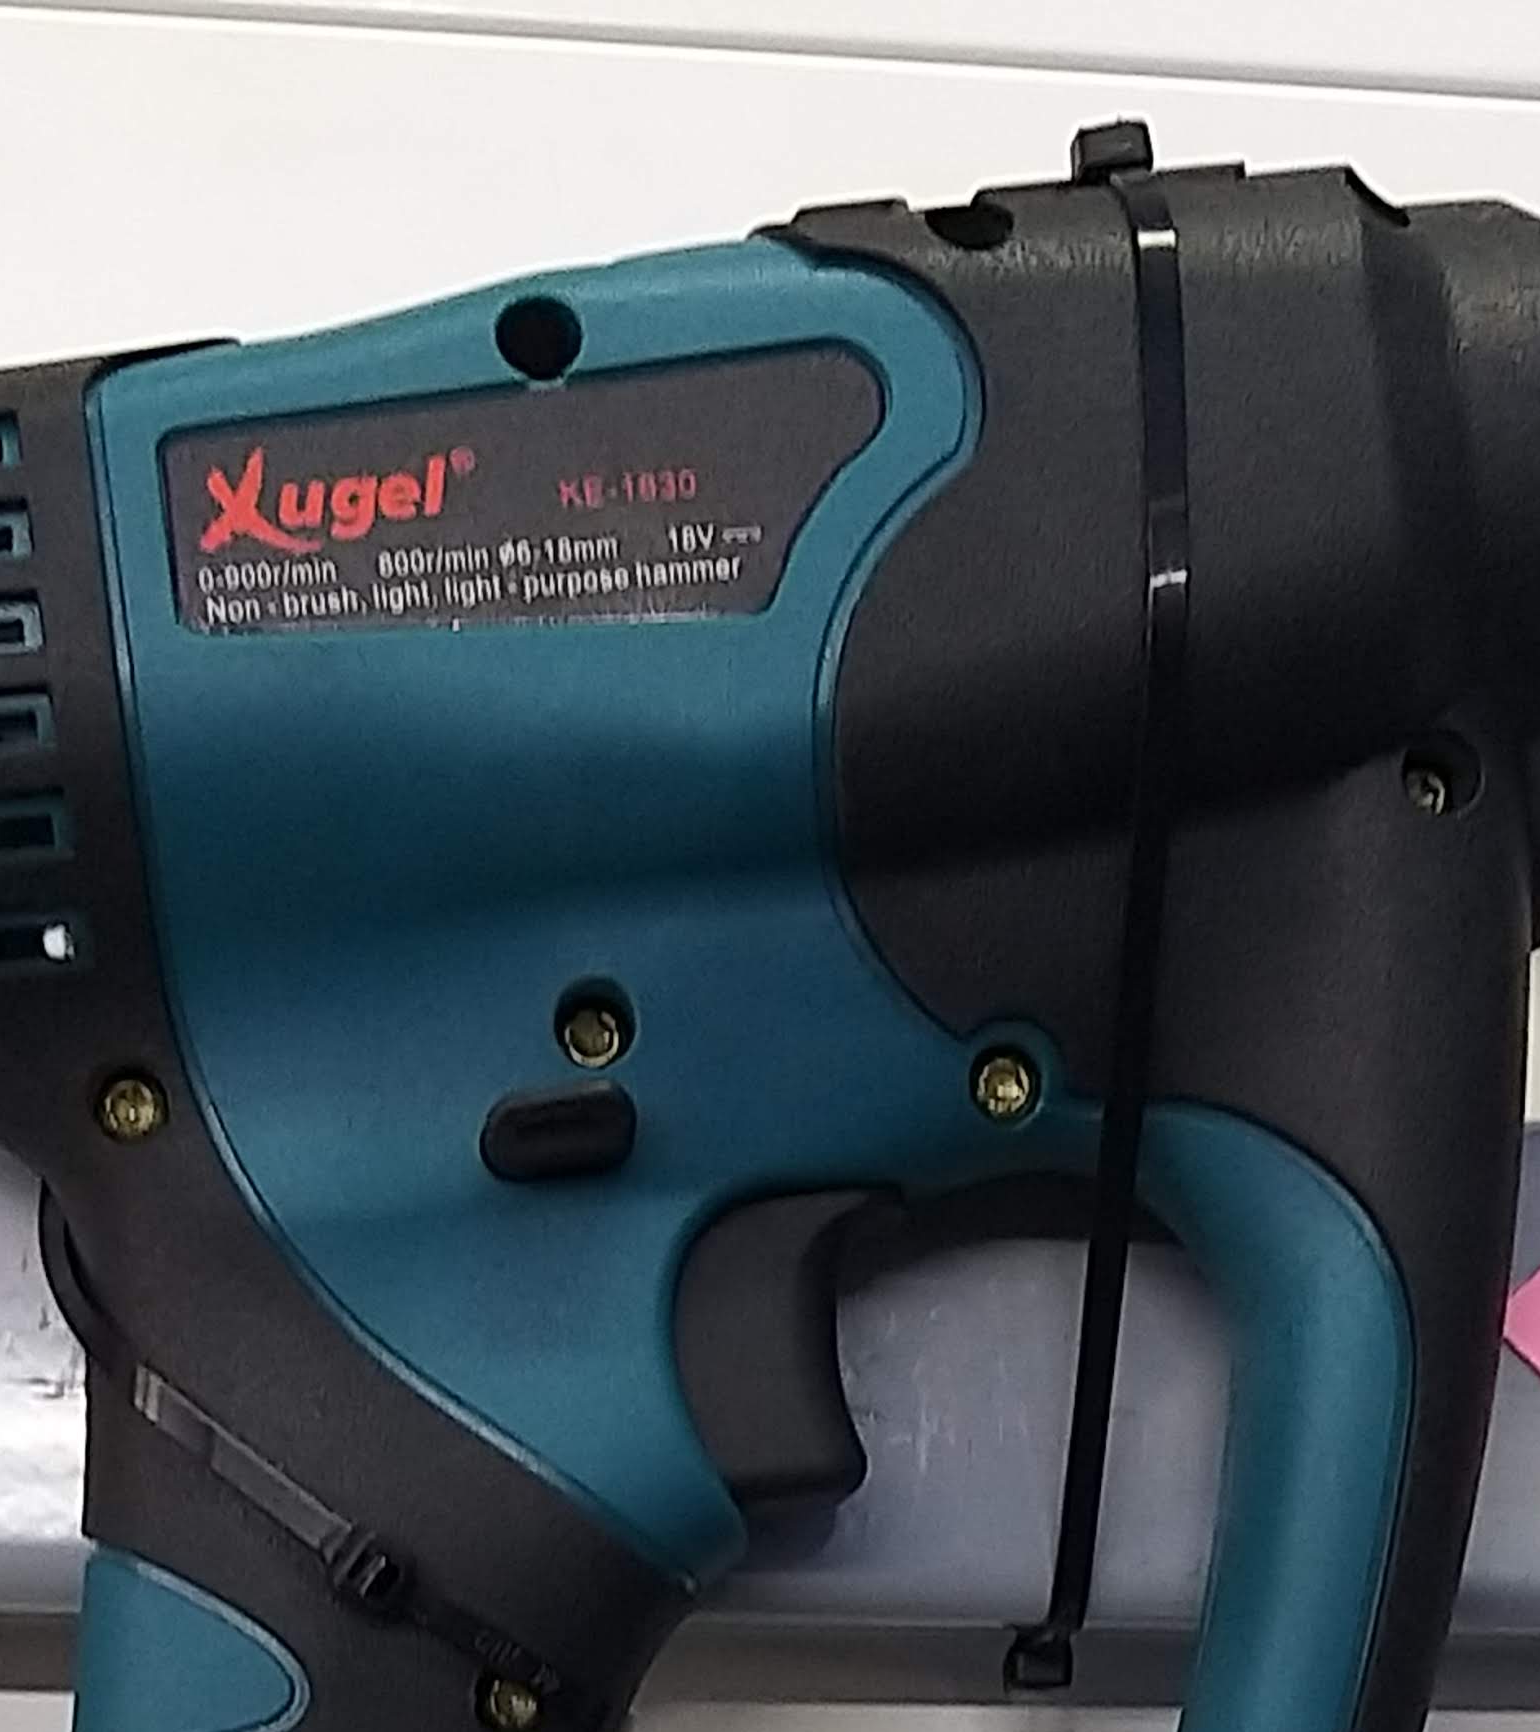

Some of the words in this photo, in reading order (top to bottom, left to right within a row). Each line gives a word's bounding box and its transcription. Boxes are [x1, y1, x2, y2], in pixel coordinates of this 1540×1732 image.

[200, 446, 446, 553] Xugel
[668, 523, 714, 553] 18V
[635, 556, 741, 589] hammer
